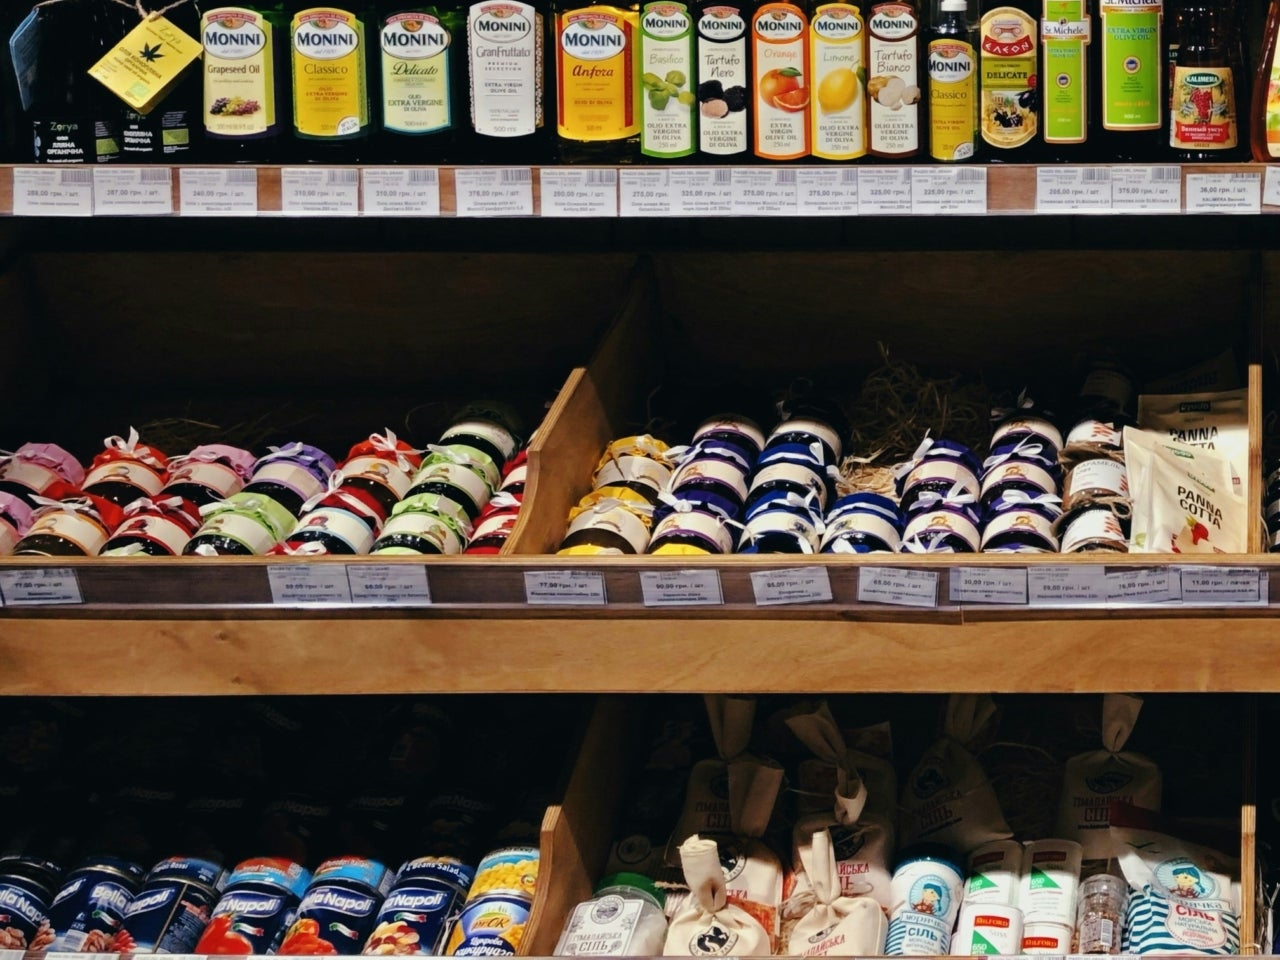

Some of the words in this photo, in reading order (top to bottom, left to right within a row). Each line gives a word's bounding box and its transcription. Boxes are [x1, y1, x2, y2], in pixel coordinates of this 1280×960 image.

[478, 21, 526, 32] MONINI
[645, 18, 686, 28] MONINI
[701, 19, 742, 30] MONINI
[758, 20, 801, 31] MONINI
[817, 20, 858, 31] MONINI
[872, 19, 913, 29] MONINI
[1054, 25, 1084, 35] Michele
[206, 33, 260, 46] MONINI
[297, 33, 353, 46] MONINI
[383, 33, 445, 46] MONINI
[565, 34, 622, 47] MONINI
[476, 46, 531, 58] GranFruttato
[764, 49, 798, 60] Orange
[823, 53, 854, 63] Limone
[874, 50, 913, 62] Tartufo
[649, 54, 684, 65] Basilico
[705, 55, 740, 66] Tartufo
[207, 64, 247, 76] Grapeseed
[249, 64, 260, 74] Oil
[304, 63, 348, 75] Classico
[391, 62, 438, 76] Delicato
[572, 65, 614, 77] Anfora
[710, 66, 735, 78] Nero
[877, 62, 911, 73] Bianco
[929, 60, 970, 72] MONINI
[987, 72, 1028, 80] DELICATE
[932, 89, 967, 100] Classico
[1177, 485, 1223, 521] PANNA
[1179, 499, 1221, 530] COTTA
[224, 898, 277, 913] Napoli
[321, 896, 373, 915] Napoli
[394, 893, 444, 907] Napoli
[1175, 904, 1215, 921] СІЛЬ
[908, 926, 938, 942] СІЛЬ
